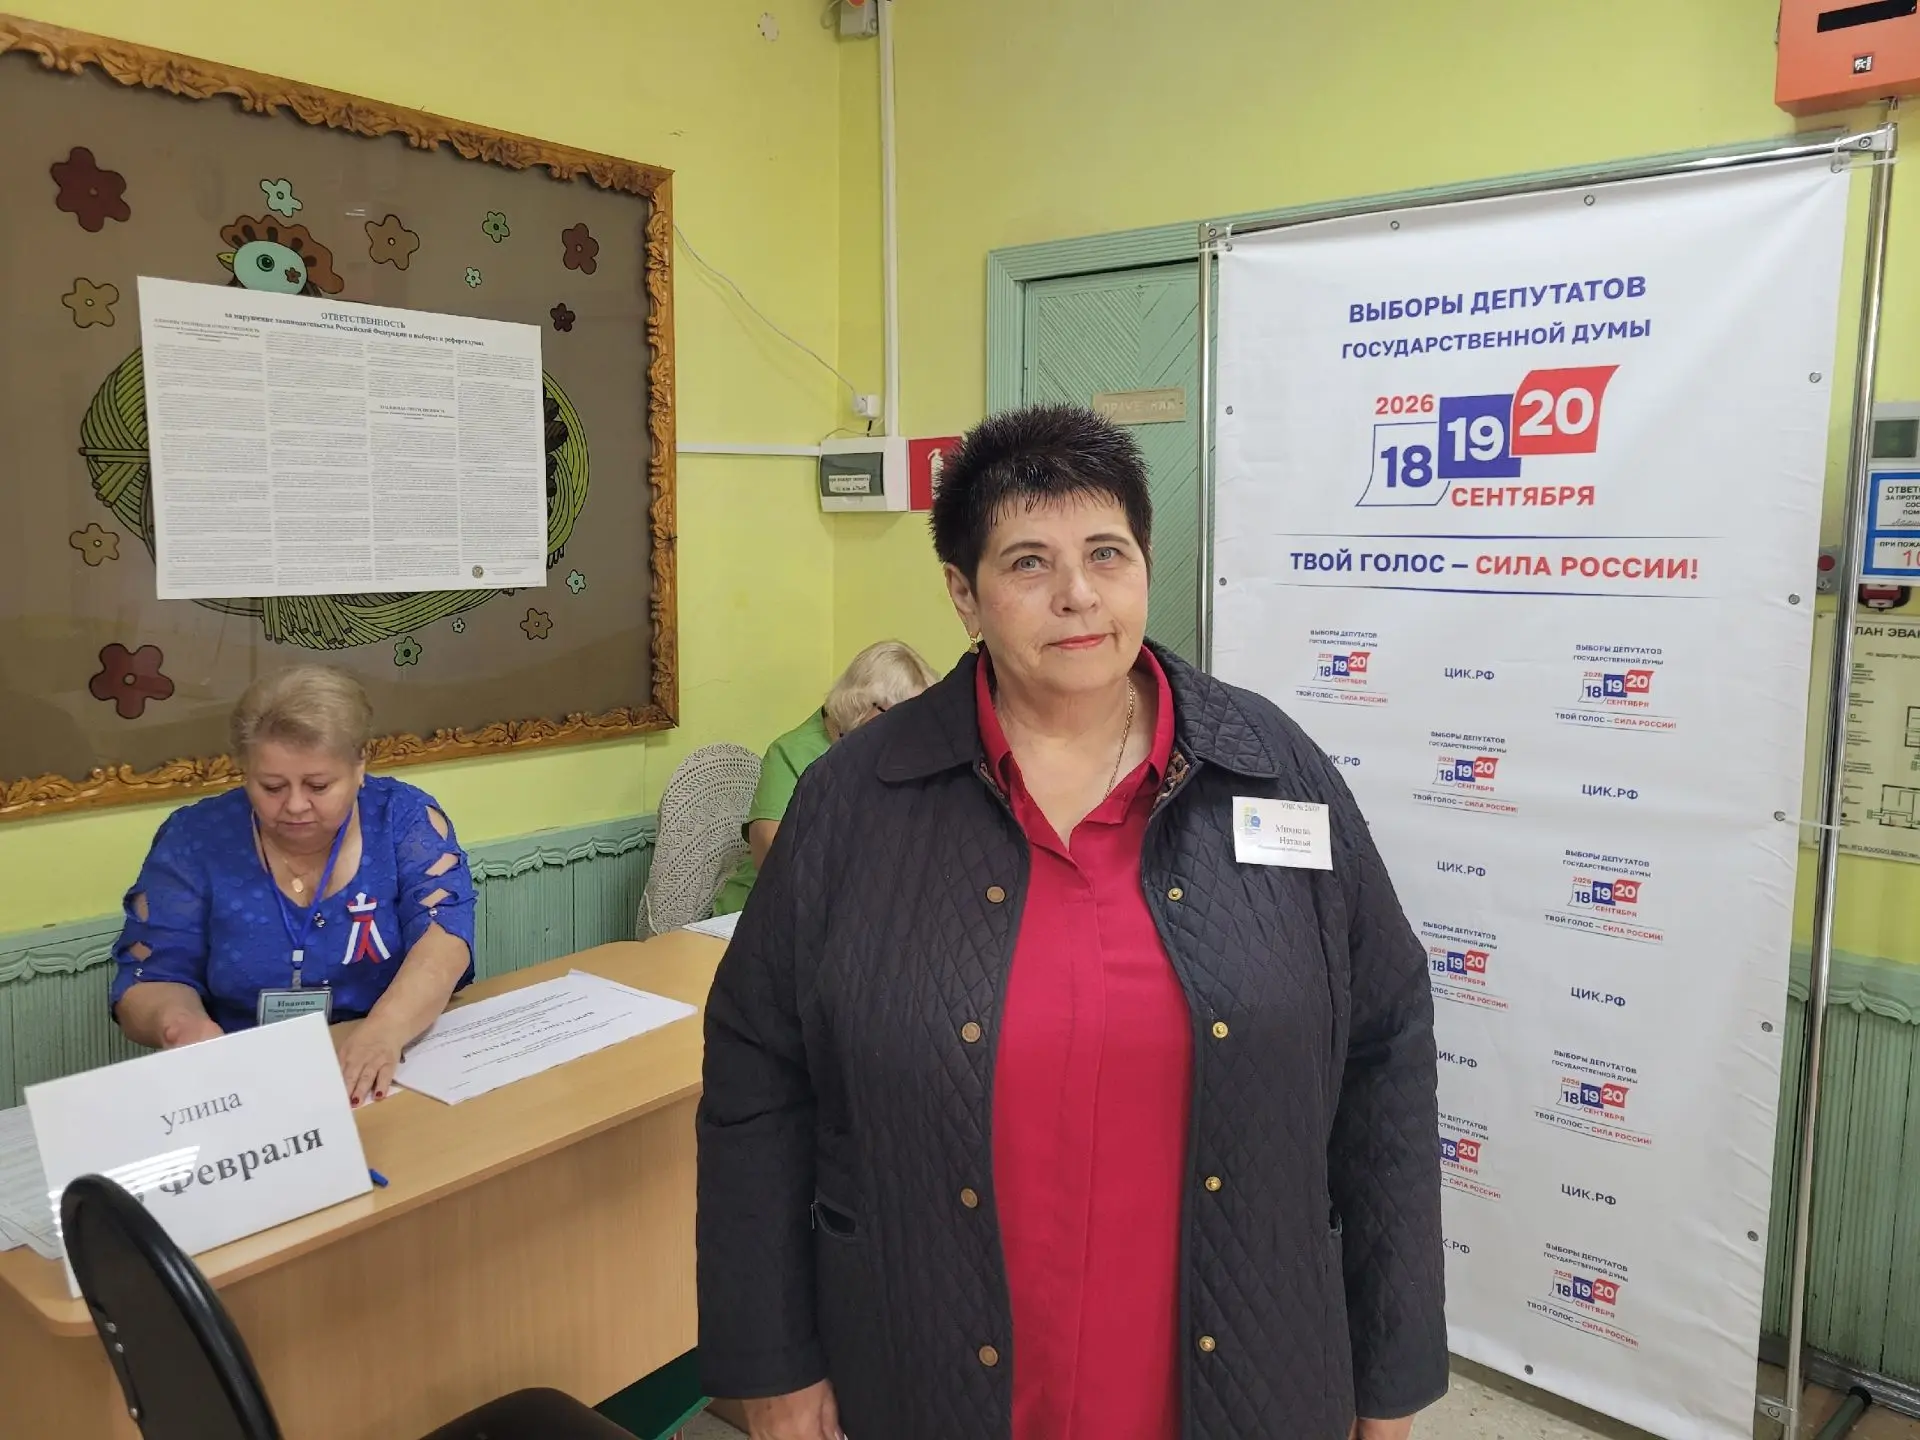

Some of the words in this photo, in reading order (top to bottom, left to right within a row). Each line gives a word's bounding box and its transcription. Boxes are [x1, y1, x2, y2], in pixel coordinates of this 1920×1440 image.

[1349, 293, 1463, 323] ВЫБОРЫ
[1470, 275, 1647, 315] ДЕПУТАТОВ
[321, 312, 406, 328] ОТВЕТСТВЕННОСТЬ
[1342, 322, 1565, 359] ГОСУДАРСТВЕННОЙ
[1571, 319, 1651, 345] ДУМЫ
[1375, 394, 1434, 414] 2026
[1380, 445, 1432, 487] 18
[1447, 416, 1504, 461] 19
[1520, 387, 1594, 436] 20
[1451, 486, 1595, 506] СЕНТЯБРЯ
[1290, 549, 1352, 571] ТВОЙ
[1360, 553, 1444, 573] ГОЛОС
[1475, 555, 1552, 576] СИЛА
[1560, 556, 1698, 579] РОССИИ!
[1855, 627, 1883, 636] ЛАН
[1576, 644, 1611, 652] ВЫБОРЫ
[1613, 646, 1662, 655] ДЕПУТАТОВ
[1319, 666, 1331, 677] 18
[1334, 660, 1347, 672] 19
[1350, 656, 1366, 668] 20
[1573, 655, 1640, 664] ГОСУДАРСТВЕННОЙ
[1444, 667, 1494, 680] ЦИК.РФ
[1585, 685, 1602, 698] 18
[1605, 679, 1623, 693] 19
[1627, 675, 1648, 689] 20
[1556, 712, 1576, 720] ТВОЙ
[1579, 714, 1605, 723] ГОЛОС
[1439, 770, 1454, 781] 18
[1457, 765, 1472, 778] 19
[1475, 761, 1494, 774] 20
[1582, 784, 1638, 800] ЦИК.РФ
[1563, 859, 1628, 874] ГОСУДАРСТВЕННОЙ
[1565, 850, 1600, 860] ВЫБОРЫ
[1602, 855, 1650, 867] ДЕПУТАТОВ
[1437, 860, 1486, 877] ЦИК.РФ
[1574, 891, 1590, 903] 18
[1594, 887, 1611, 900] 19
[1615, 884, 1636, 898] 20
[1545, 914, 1566, 923] ТВОЙ
[1567, 919, 1593, 928] ГОЛОС
[1423, 921, 1453, 932] ВЫБОРЫ
[1455, 928, 1496, 940] ДЕПУТАТОВ
[1432, 960, 1445, 972] 18
[1449, 957, 1463, 969] 19
[1467, 954, 1484, 968] 20
[1571, 986, 1625, 1006] ЦИК.РФ
[1439, 1051, 1477, 1067] ИК.РФ
[1554, 1050, 1588, 1063] ВЫБОРЫ
[1590, 1058, 1637, 1074] ДЕПУТАТОВ
[1552, 1059, 1615, 1079] ГОСУДАРСТВЕННОЙ
[1563, 1091, 1579, 1104] 18
[1583, 1089, 1599, 1102] 19
[1603, 1088, 1623, 1102] 20
[160, 1093, 242, 1135] улица
[1535, 1112, 1555, 1122] ТВОЙ
[1557, 1118, 1582, 1129] ГОЛОС
[1439, 1122, 1470, 1134] СТВЕННОЙ
[1441, 1143, 1456, 1157] 19
[1459, 1142, 1476, 1158] 20
[1561, 1184, 1616, 1205] ЦИК.РФ
[1442, 1238, 1470, 1254] К.РФ
[1546, 1243, 1580, 1257] ВЫБОРЫ
[1582, 1253, 1628, 1271] ДЕПУТАТОВ
[1556, 1284, 1571, 1297] 18
[1575, 1283, 1591, 1297] 19
[1595, 1283, 1615, 1299] 20
